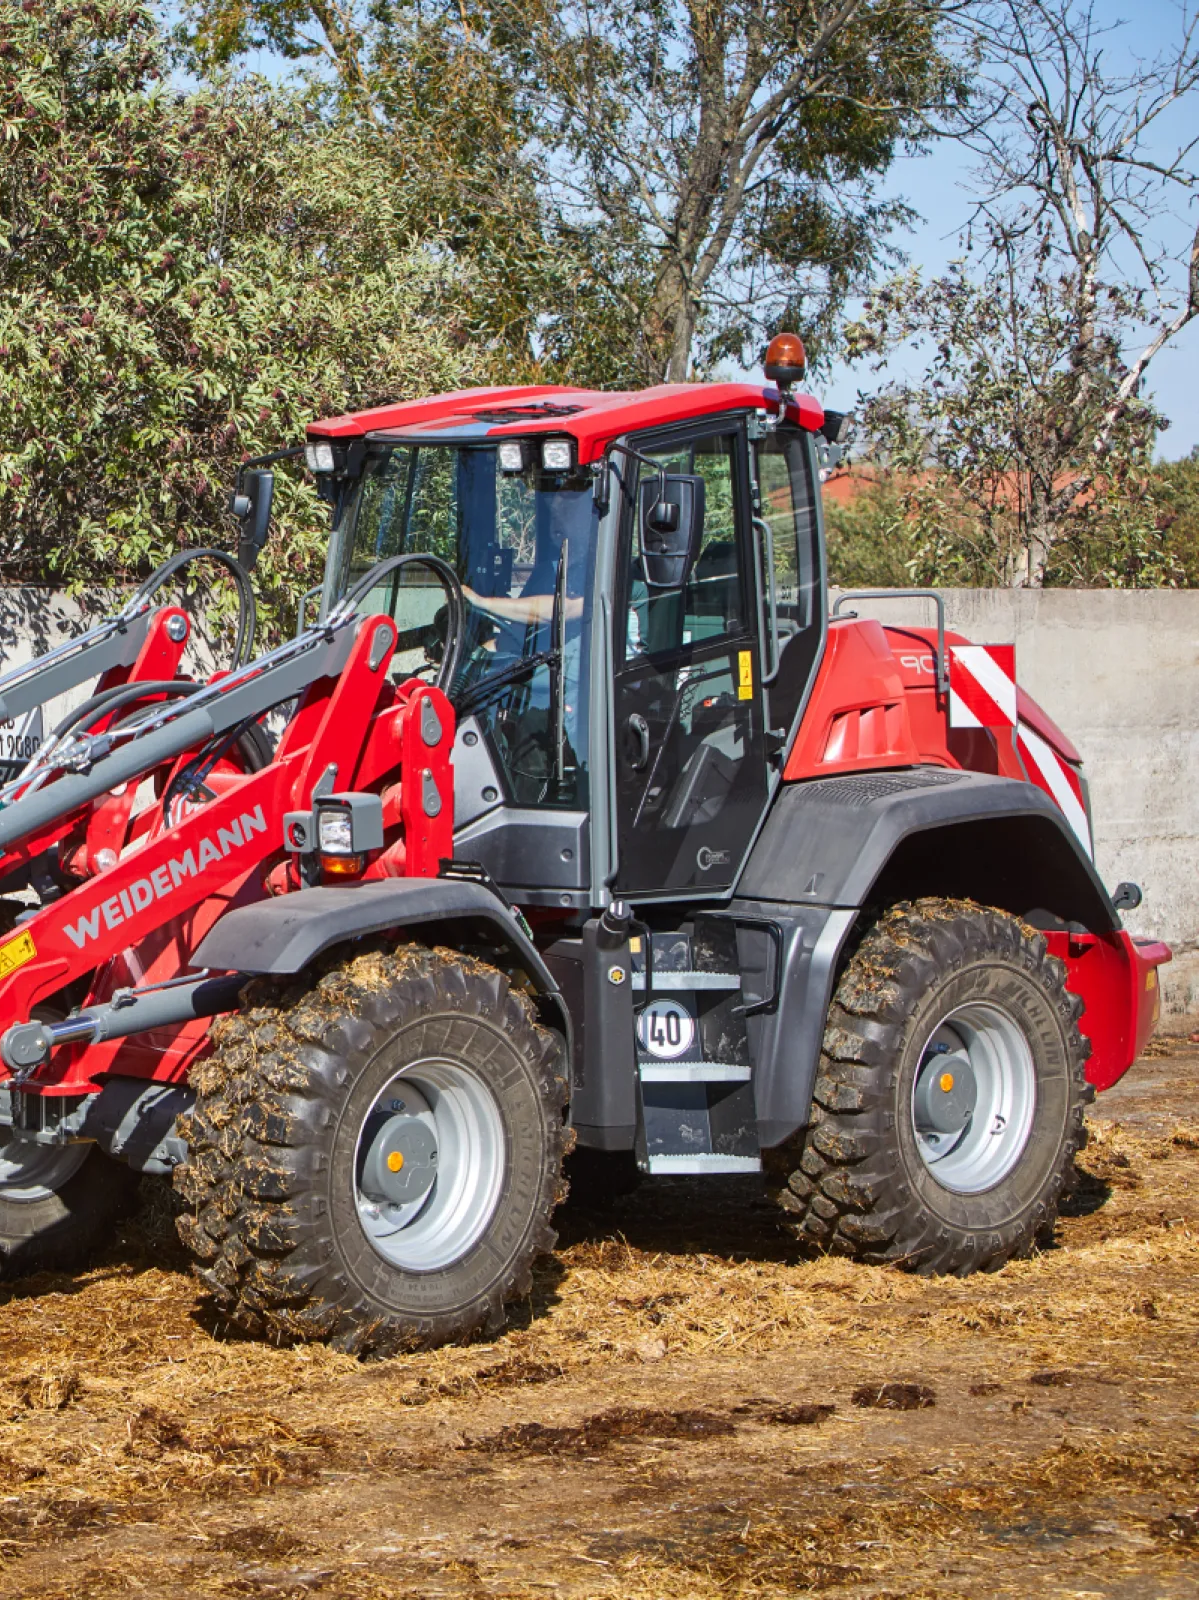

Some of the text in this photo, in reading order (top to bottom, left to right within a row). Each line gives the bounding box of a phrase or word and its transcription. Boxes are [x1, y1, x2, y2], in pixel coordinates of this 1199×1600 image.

[62, 804, 268, 949] WEIDEMANN
[650, 1009, 682, 1047] 40
[1002, 980, 1061, 1064] MICHELIN
